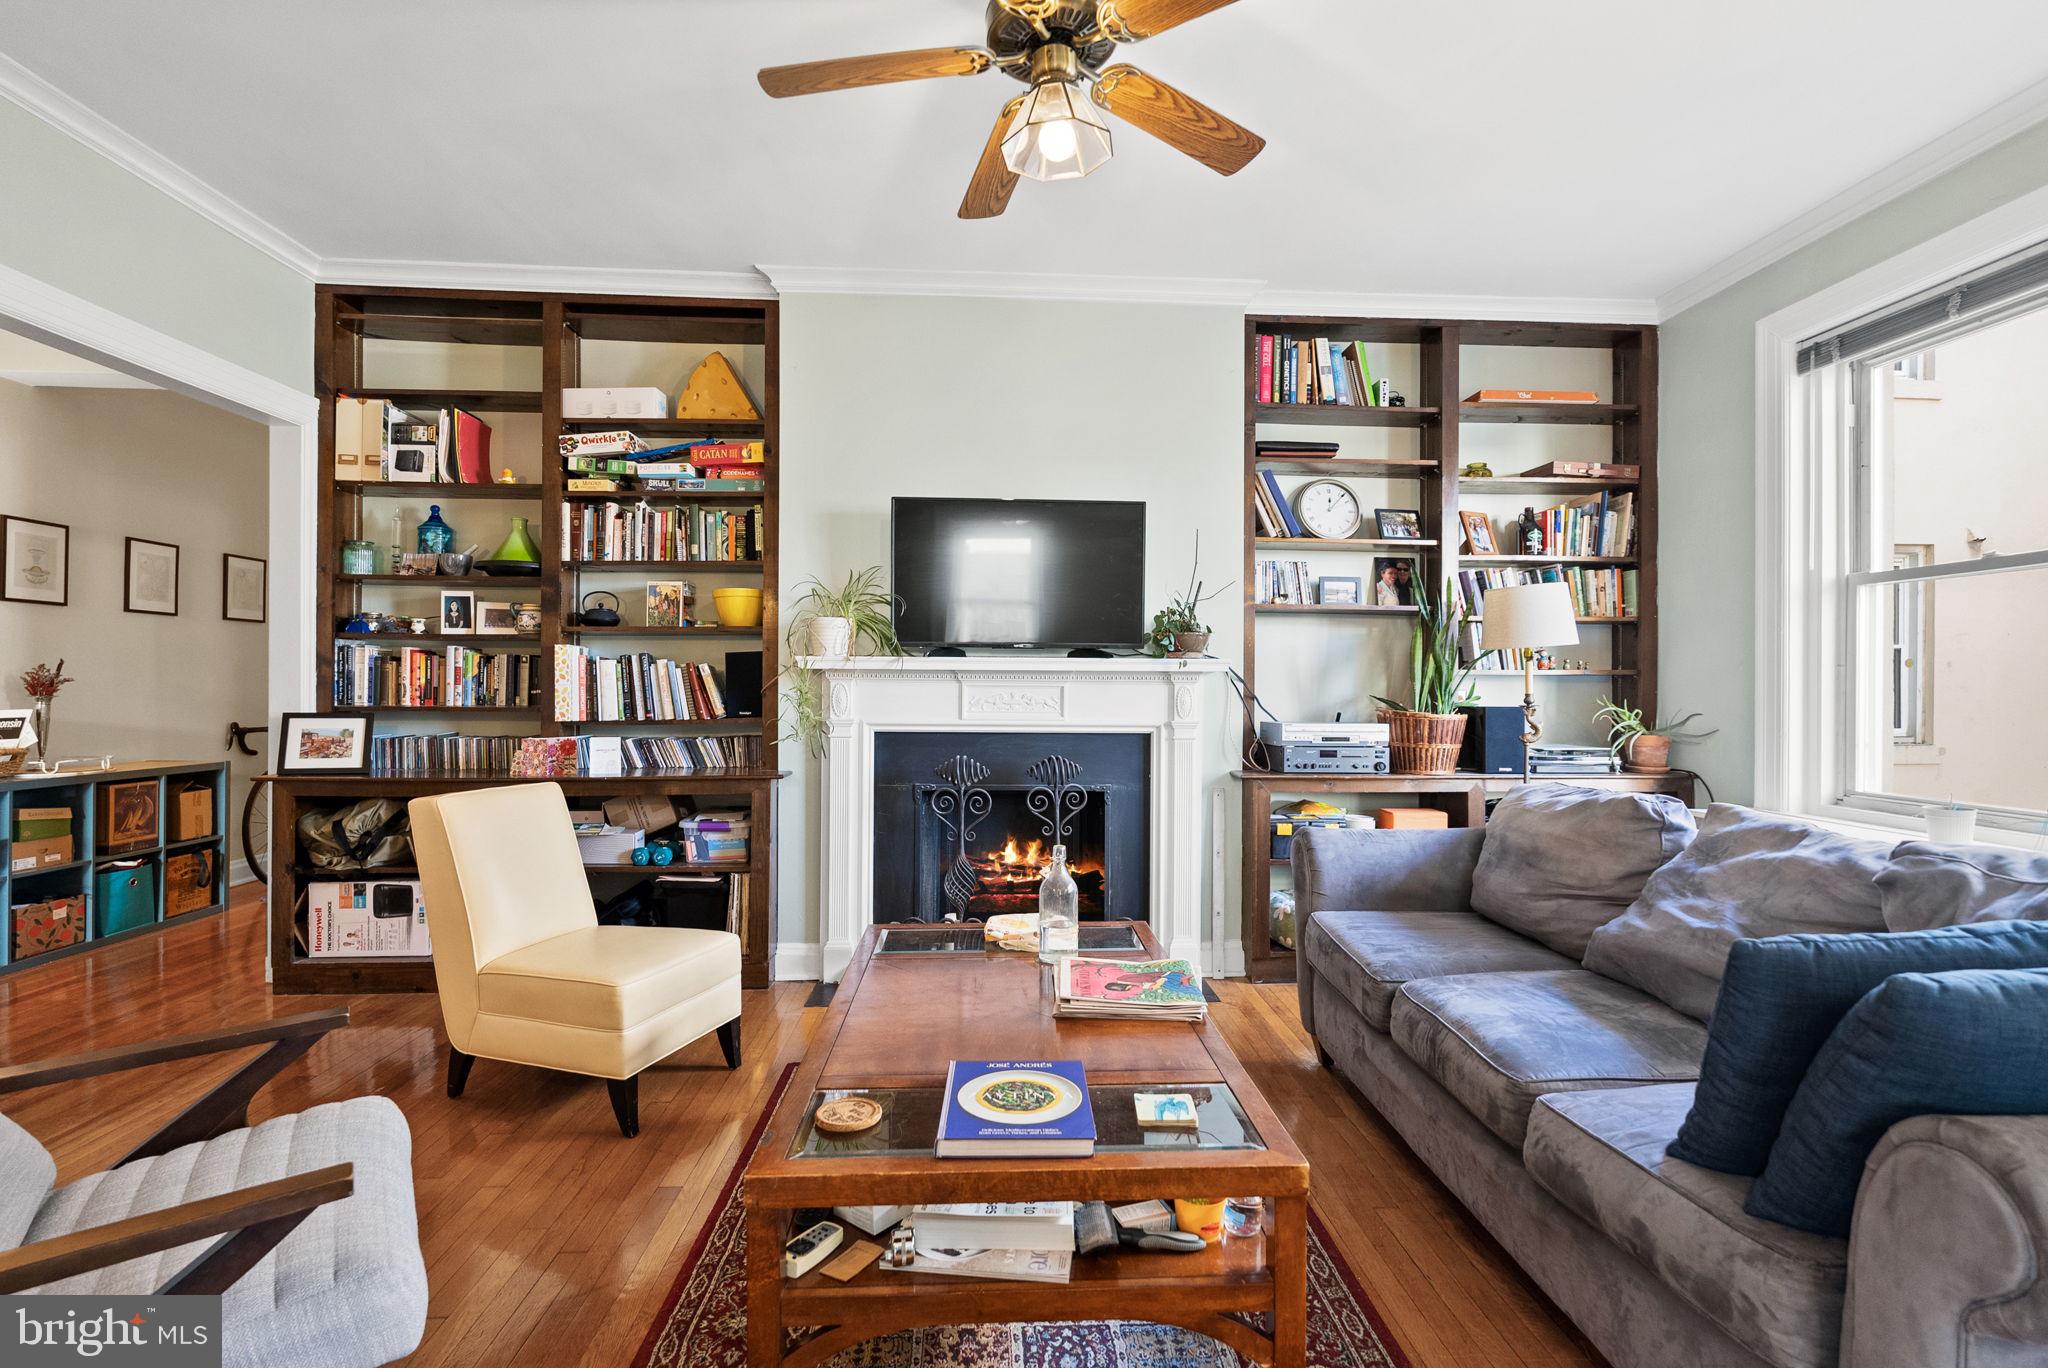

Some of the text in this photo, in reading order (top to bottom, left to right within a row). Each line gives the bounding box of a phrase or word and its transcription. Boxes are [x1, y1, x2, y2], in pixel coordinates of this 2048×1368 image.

[580, 434, 617, 446] Qwirkle
[699, 448, 728, 460] CATAN
[648, 479, 671, 487] SKULL
[314, 907, 323, 952] Honeywell
